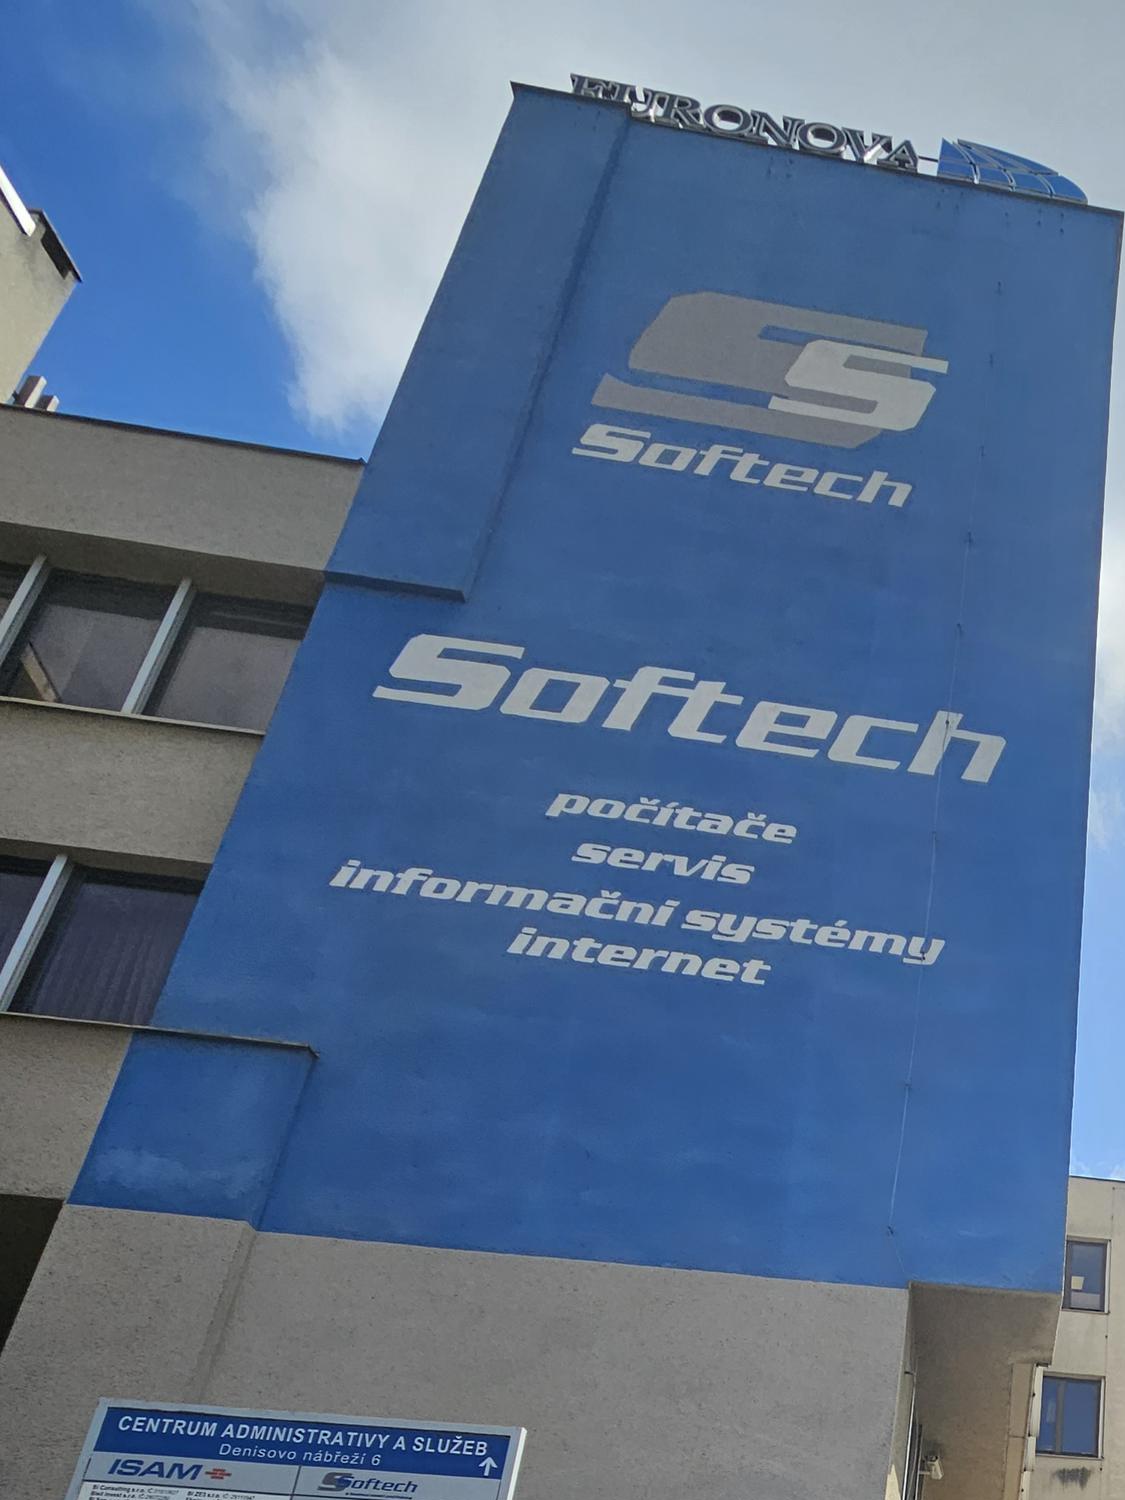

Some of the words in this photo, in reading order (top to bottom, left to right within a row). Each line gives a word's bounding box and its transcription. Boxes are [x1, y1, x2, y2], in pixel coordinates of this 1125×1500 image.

[570, 73, 919, 172] EURONOVA
[571, 423, 913, 508] Softech
[371, 633, 1007, 784] Softech
[545, 793, 798, 845] počítače
[571, 842, 756, 886] servis
[329, 860, 680, 927] informační
[681, 908, 946, 966] systémy
[507, 928, 771, 986] internet
[118, 1415, 218, 1437] CENTRUM
[221, 1423, 391, 1449] ADMINISTRATIVY
[392, 1436, 406, 1450] A
[412, 1435, 488, 1456] SLUŽEB
[219, 1443, 297, 1460] Denisovo
[303, 1449, 366, 1465] nábřeží
[371, 1454, 381, 1466] 6
[107, 1458, 203, 1481] ISAM
[317, 1471, 418, 1494] Softech
